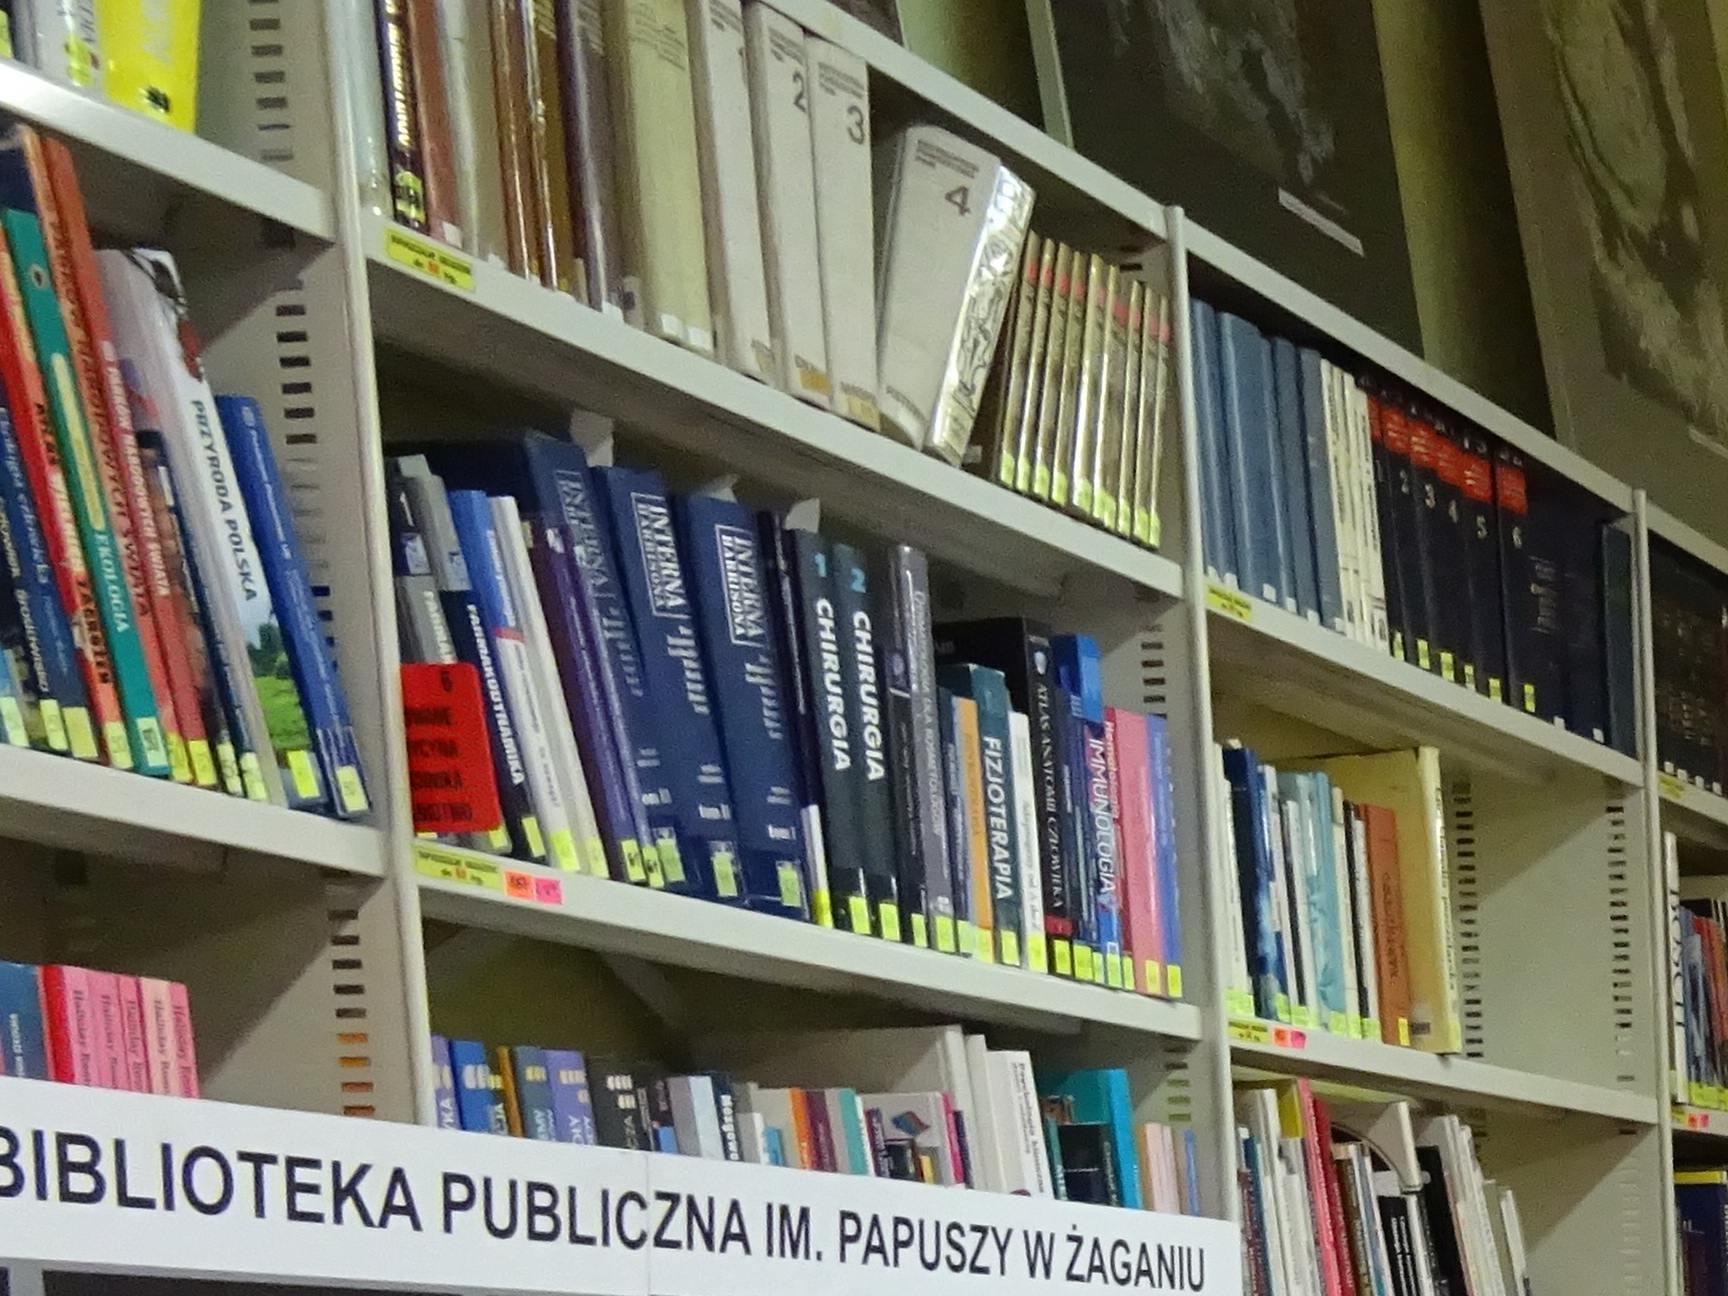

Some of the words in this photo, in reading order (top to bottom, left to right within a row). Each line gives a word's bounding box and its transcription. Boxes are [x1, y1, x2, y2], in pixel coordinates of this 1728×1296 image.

[847, 104, 865, 145] 3
[944, 185, 971, 217] 4
[192, 397, 235, 514] PRZYRODA
[224, 516, 260, 603] POLSKA
[1476, 515, 1488, 539] 5
[91, 531, 134, 633] EKOLOGIA
[648, 504, 688, 610] INTERNA
[731, 537, 768, 638] INTERNA
[813, 553, 827, 577] 1
[850, 568, 866, 593] 2
[816, 598, 850, 771] CHIRURGIA
[852, 610, 885, 782] CHIRURGIA
[1034, 682, 1053, 730] ATLAS
[977, 734, 1020, 900] FIZJOTERAPIA
[1082, 737, 1122, 894] IMMUNOLOGIA
[0, 1125, 421, 1232] BIBLIOTEKA
[443, 1172, 750, 1256] PUBLICZNA
[766, 1201, 823, 1263] IM.
[839, 1210, 1011, 1278] PAPUSZY
[1023, 1232, 1060, 1279] W
[1066, 1223, 1206, 1294] ŻAGANIU
